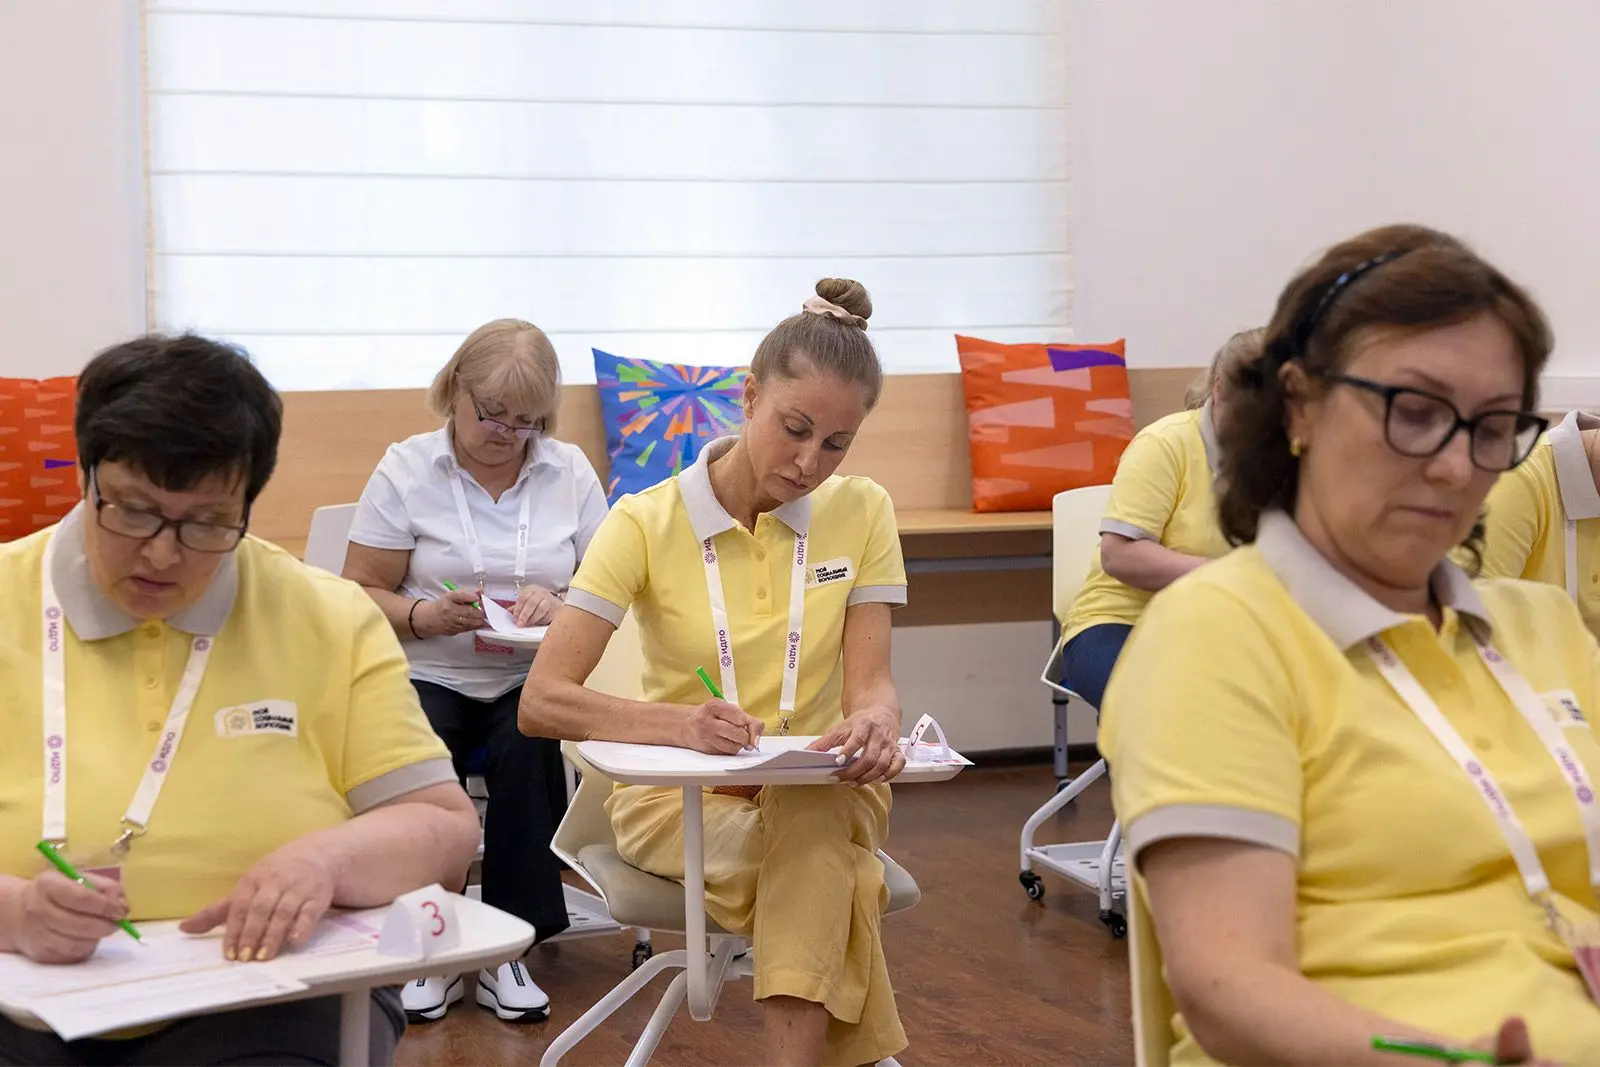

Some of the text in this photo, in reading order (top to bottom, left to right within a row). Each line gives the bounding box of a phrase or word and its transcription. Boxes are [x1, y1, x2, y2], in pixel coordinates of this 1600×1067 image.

[796, 541, 805, 566] ИДПО
[815, 566, 828, 574] МОЙ
[48, 622, 59, 652] ИДПО
[718, 629, 729, 654] ИДПО
[788, 644, 798, 669] ИДПО
[910, 723, 925, 747] 5
[51, 751, 60, 784] ИДПО
[421, 900, 446, 938] 3
